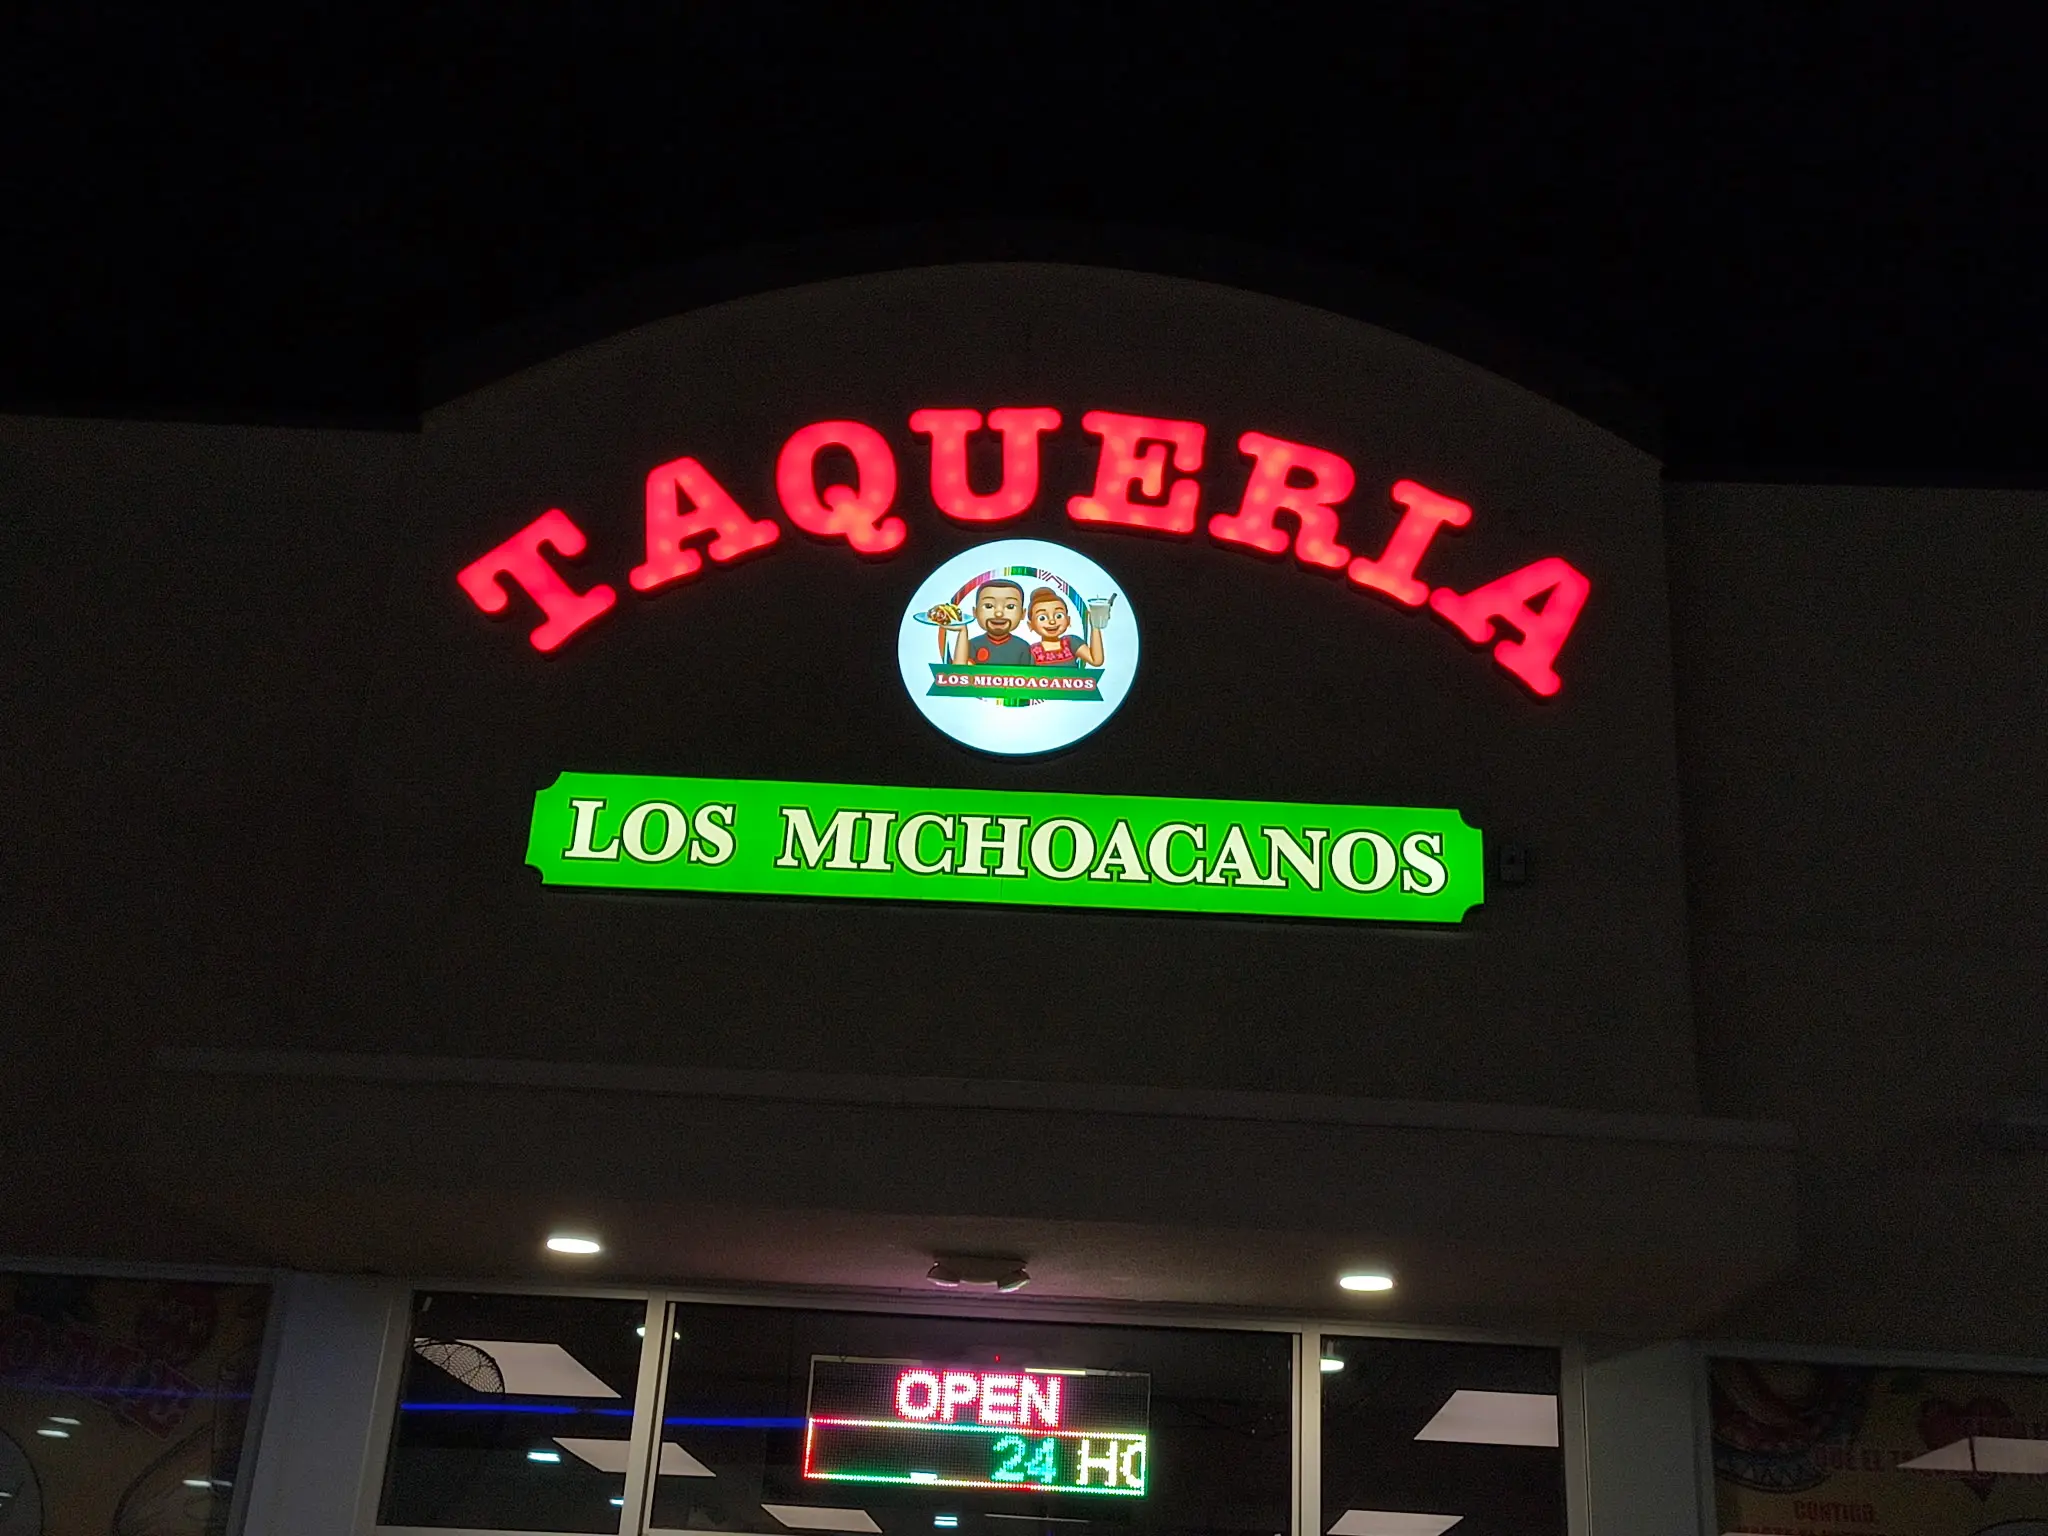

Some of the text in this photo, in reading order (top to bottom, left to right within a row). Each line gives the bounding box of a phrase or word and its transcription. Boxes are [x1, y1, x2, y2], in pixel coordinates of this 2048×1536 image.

[457, 407, 1592, 699] TAQUERIA
[935, 673, 1096, 691] LOS MICHOACANOS
[564, 799, 1448, 894] LOS MICHOACANOS
[896, 1369, 1062, 1428] OPEN
[991, 1435, 1057, 1484] 24
